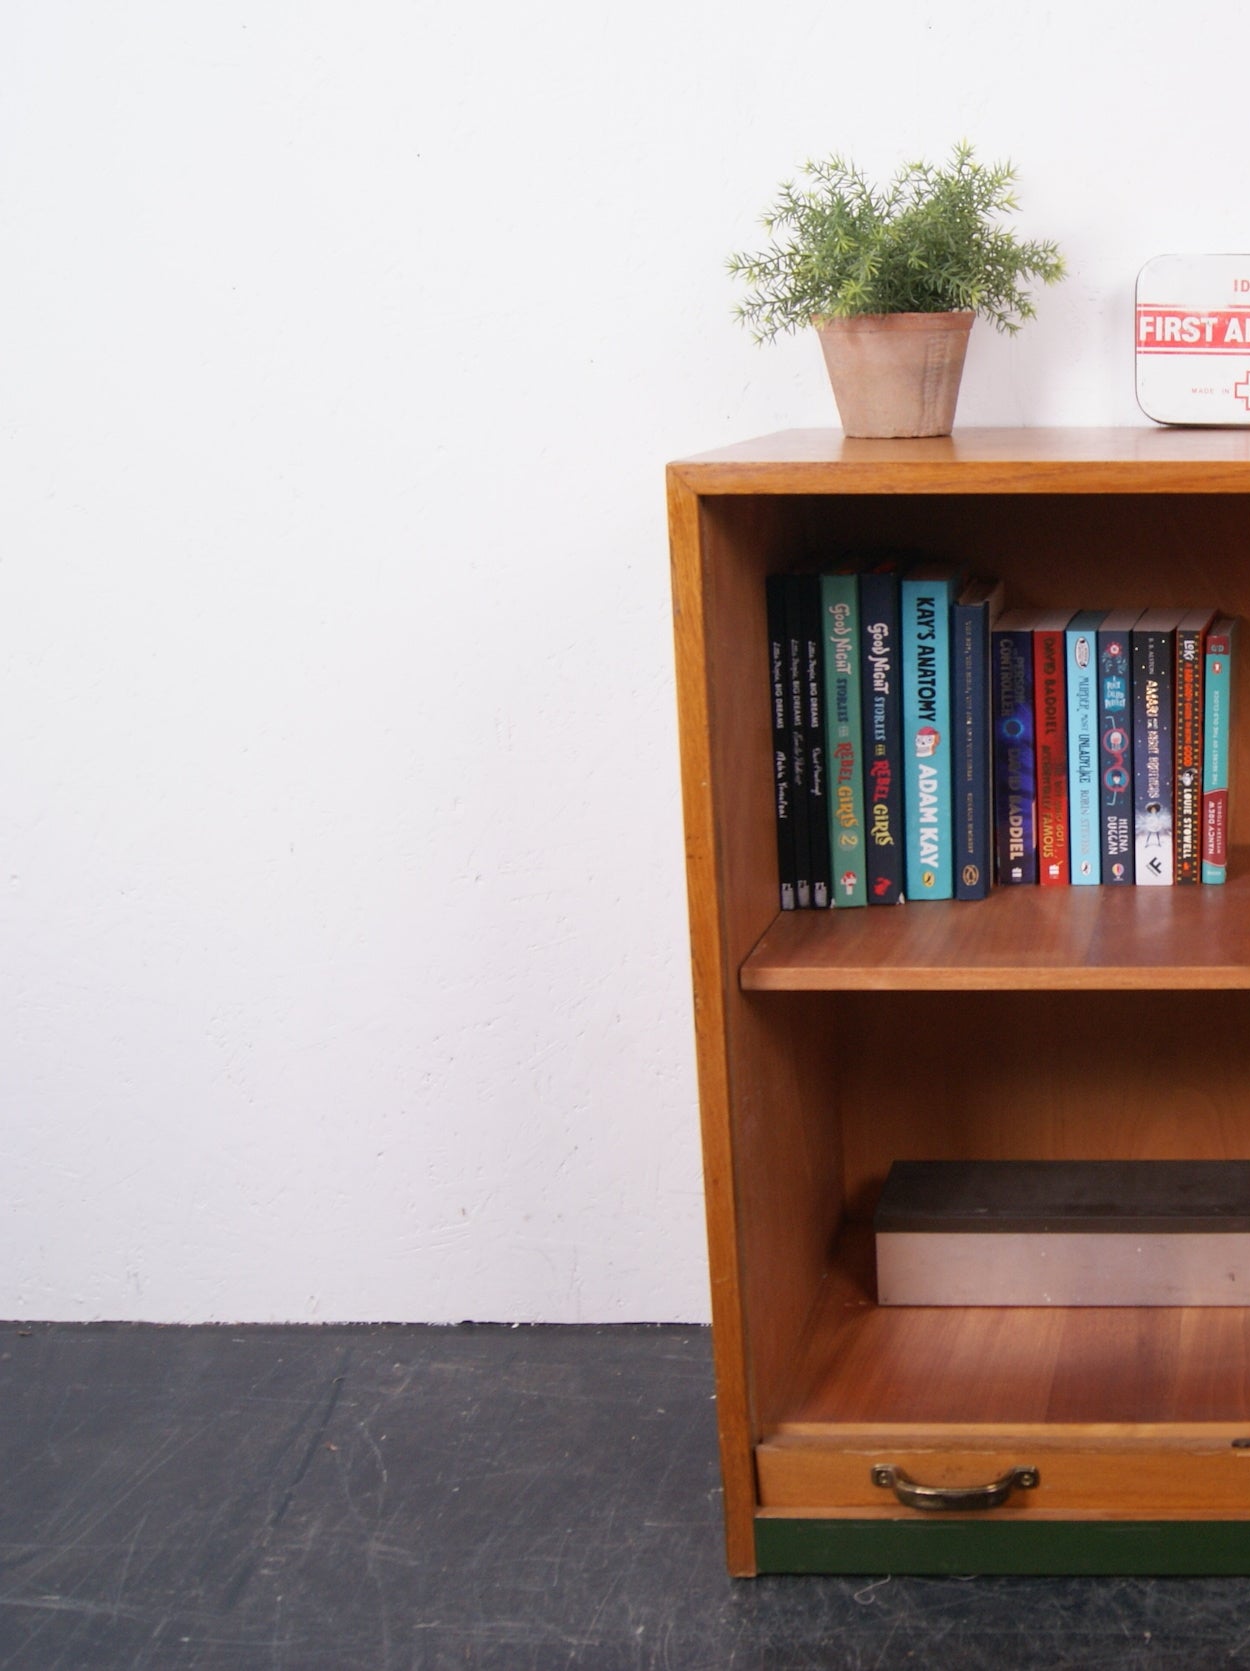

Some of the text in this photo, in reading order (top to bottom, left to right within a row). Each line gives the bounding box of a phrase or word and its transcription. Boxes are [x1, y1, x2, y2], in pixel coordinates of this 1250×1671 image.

[1139, 315, 1218, 342] FIRST
[775, 683, 783, 697] BIG
[792, 681, 801, 694] BIG
[810, 682, 818, 695] BIG
[836, 678, 848, 722] STORIES
[1044, 637, 1057, 734] DAVID BADDIEL
[1146, 680, 1159, 717] AMARI
[775, 698, 784, 729] DREAMS
[793, 695, 802, 726] DREAMS
[810, 698, 818, 728] DREAMS
[873, 696, 886, 740] STORIES
[916, 597, 939, 868] KAY'S ANATOMY ADAM KAY
[834, 742, 854, 784] REBEL
[1077, 734, 1093, 783] UNLADYLIKE
[869, 760, 891, 802] REBEL
[1008, 748, 1024, 860] DAVID BADDIEL
[1080, 789, 1090, 815] ROBIN
[841, 834, 858, 846] 2
[1043, 814, 1053, 858] FAMOUS
[1056, 824, 1064, 841] GOT
[1107, 815, 1119, 855] DUGGAN
[1119, 819, 1129, 852] HELENA
[1182, 788, 1193, 859] LOUIE STOWELL
[1208, 801, 1216, 854] NANCY DREW
